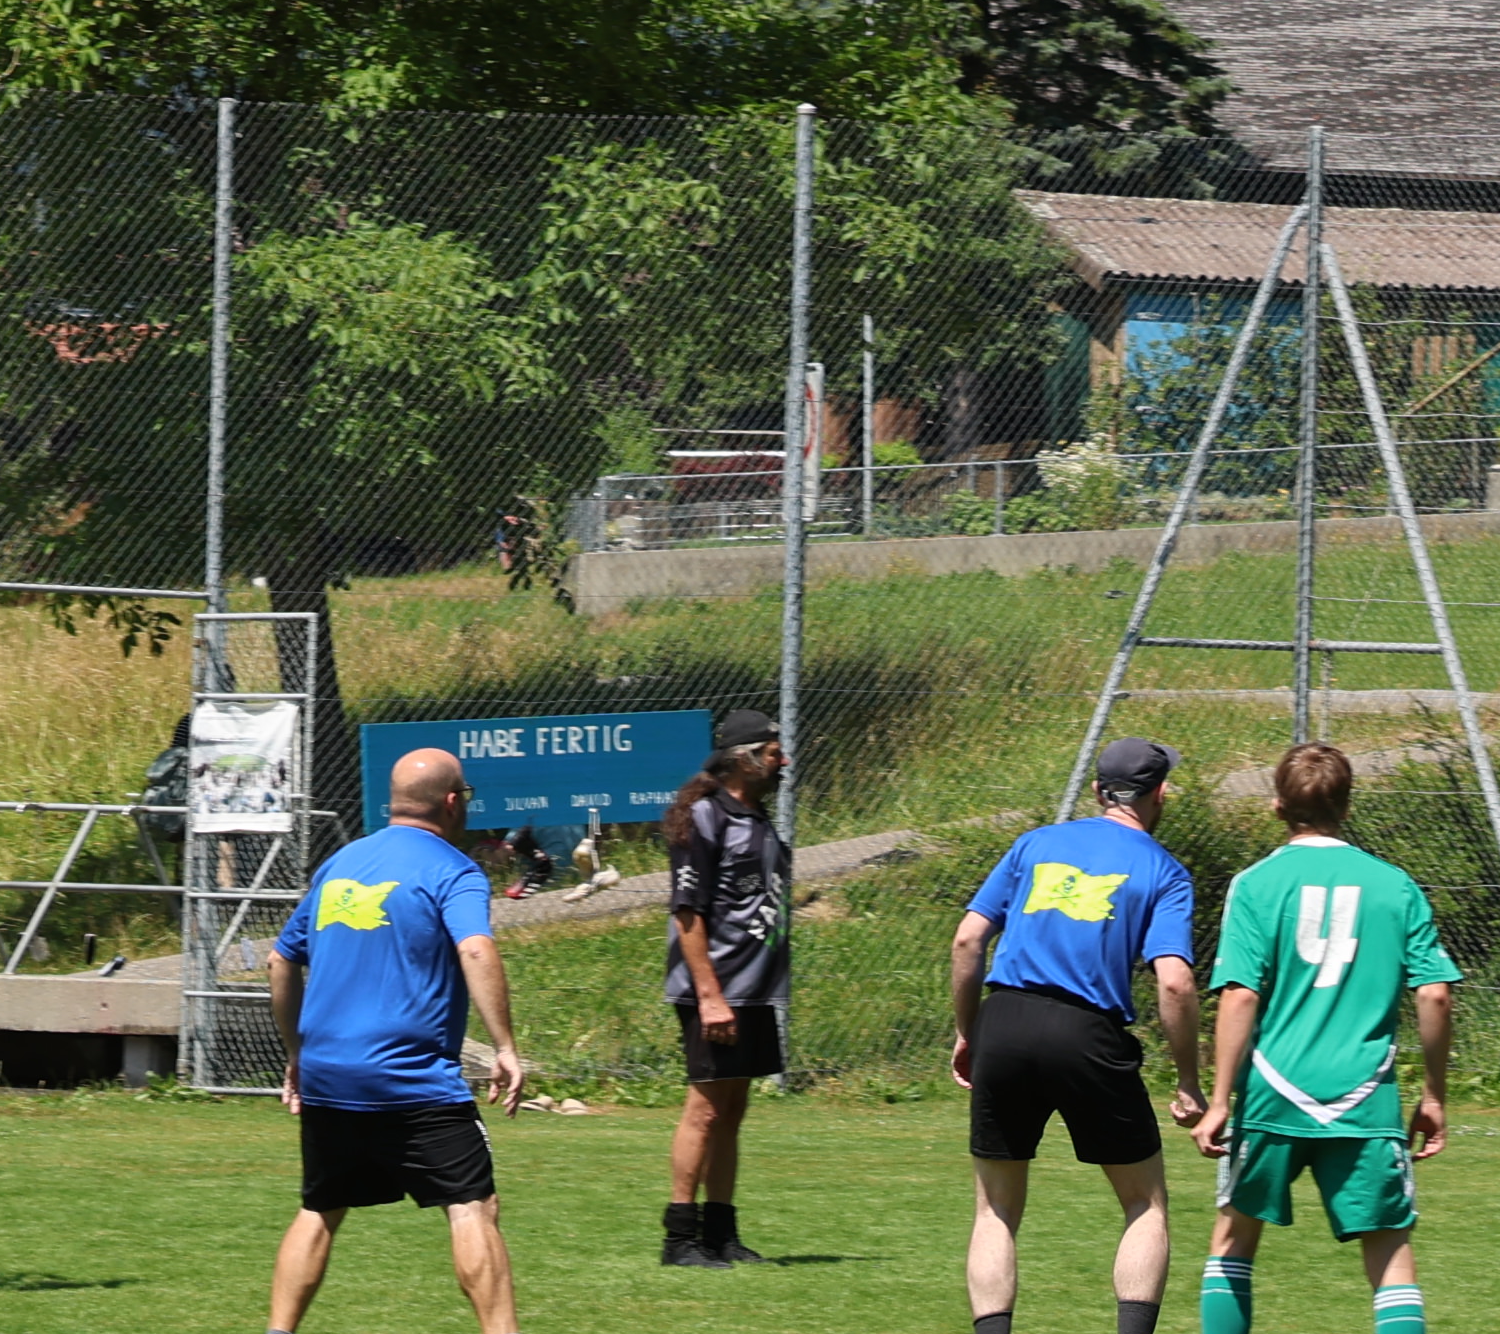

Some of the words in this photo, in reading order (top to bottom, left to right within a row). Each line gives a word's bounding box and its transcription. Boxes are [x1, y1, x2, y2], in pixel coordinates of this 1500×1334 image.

[459, 728, 526, 759] HABE
[536, 724, 632, 755] FERTIG
[1296, 885, 1361, 988] 4
